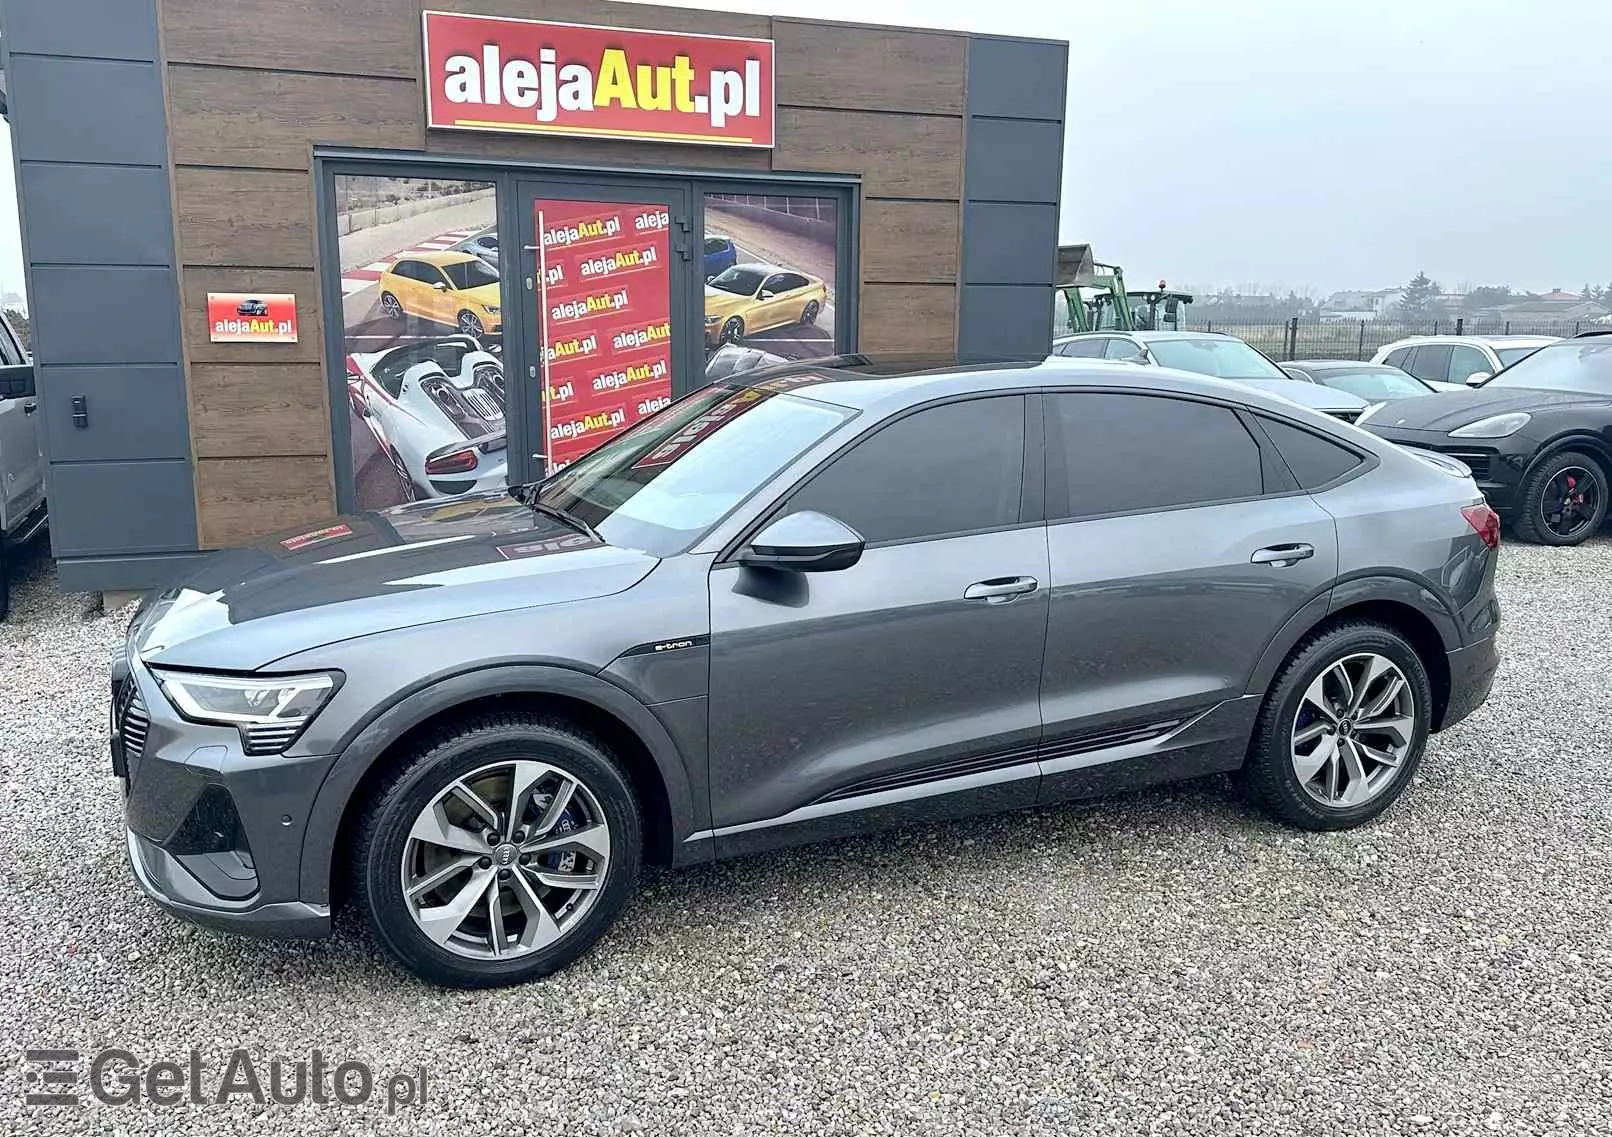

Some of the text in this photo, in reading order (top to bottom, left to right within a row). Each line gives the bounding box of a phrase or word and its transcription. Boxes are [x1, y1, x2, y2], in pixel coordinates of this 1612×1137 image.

[444, 44, 760, 128] alejaAut.pl
[544, 216, 621, 245] alejaAut.pl
[580, 246, 657, 275] alejaAut.pl
[551, 290, 629, 320] alejaAut.pl
[215, 319, 292, 336] alejaAut.pl
[613, 323, 671, 349] alejaAut
[592, 360, 667, 390] alejaAut.pl
[550, 408, 626, 439] alejaAut.pl
[655, 640, 693, 651] e-tron
